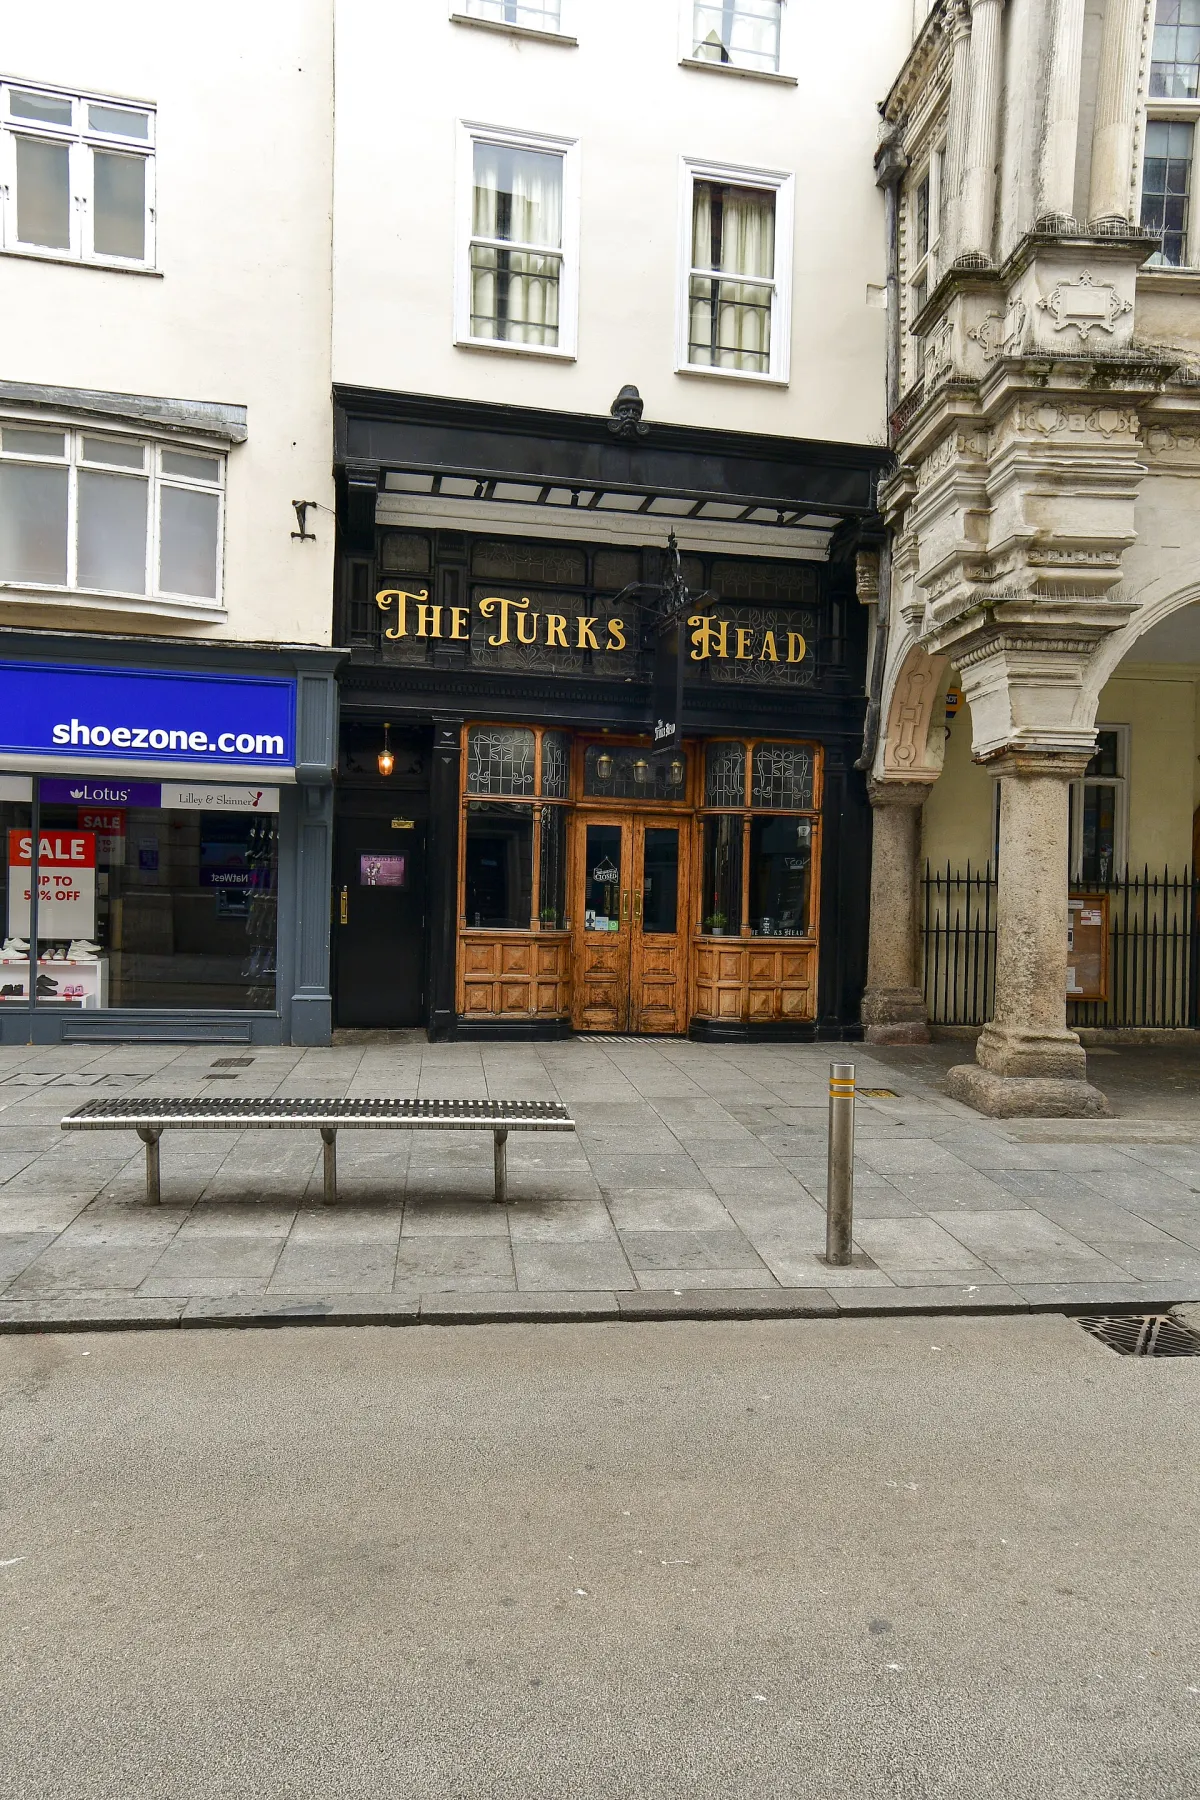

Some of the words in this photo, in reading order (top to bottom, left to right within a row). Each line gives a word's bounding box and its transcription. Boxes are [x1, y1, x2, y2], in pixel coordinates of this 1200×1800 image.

[375, 589, 470, 640] THE
[479, 597, 627, 651] TURKS
[687, 614, 807, 663] HEAD
[52, 719, 284, 755] shoezone.com
[84, 785, 128, 801] Lotus
[178, 793, 203, 804] Lilley
[205, 795, 214, 804] &
[216, 795, 252, 806] Skinner
[83, 815, 120, 829] SALE
[19, 837, 85, 860] SALE
[53, 876, 73, 887] TO
[24, 890, 52, 901] 5%
[55, 891, 80, 901] OFF
